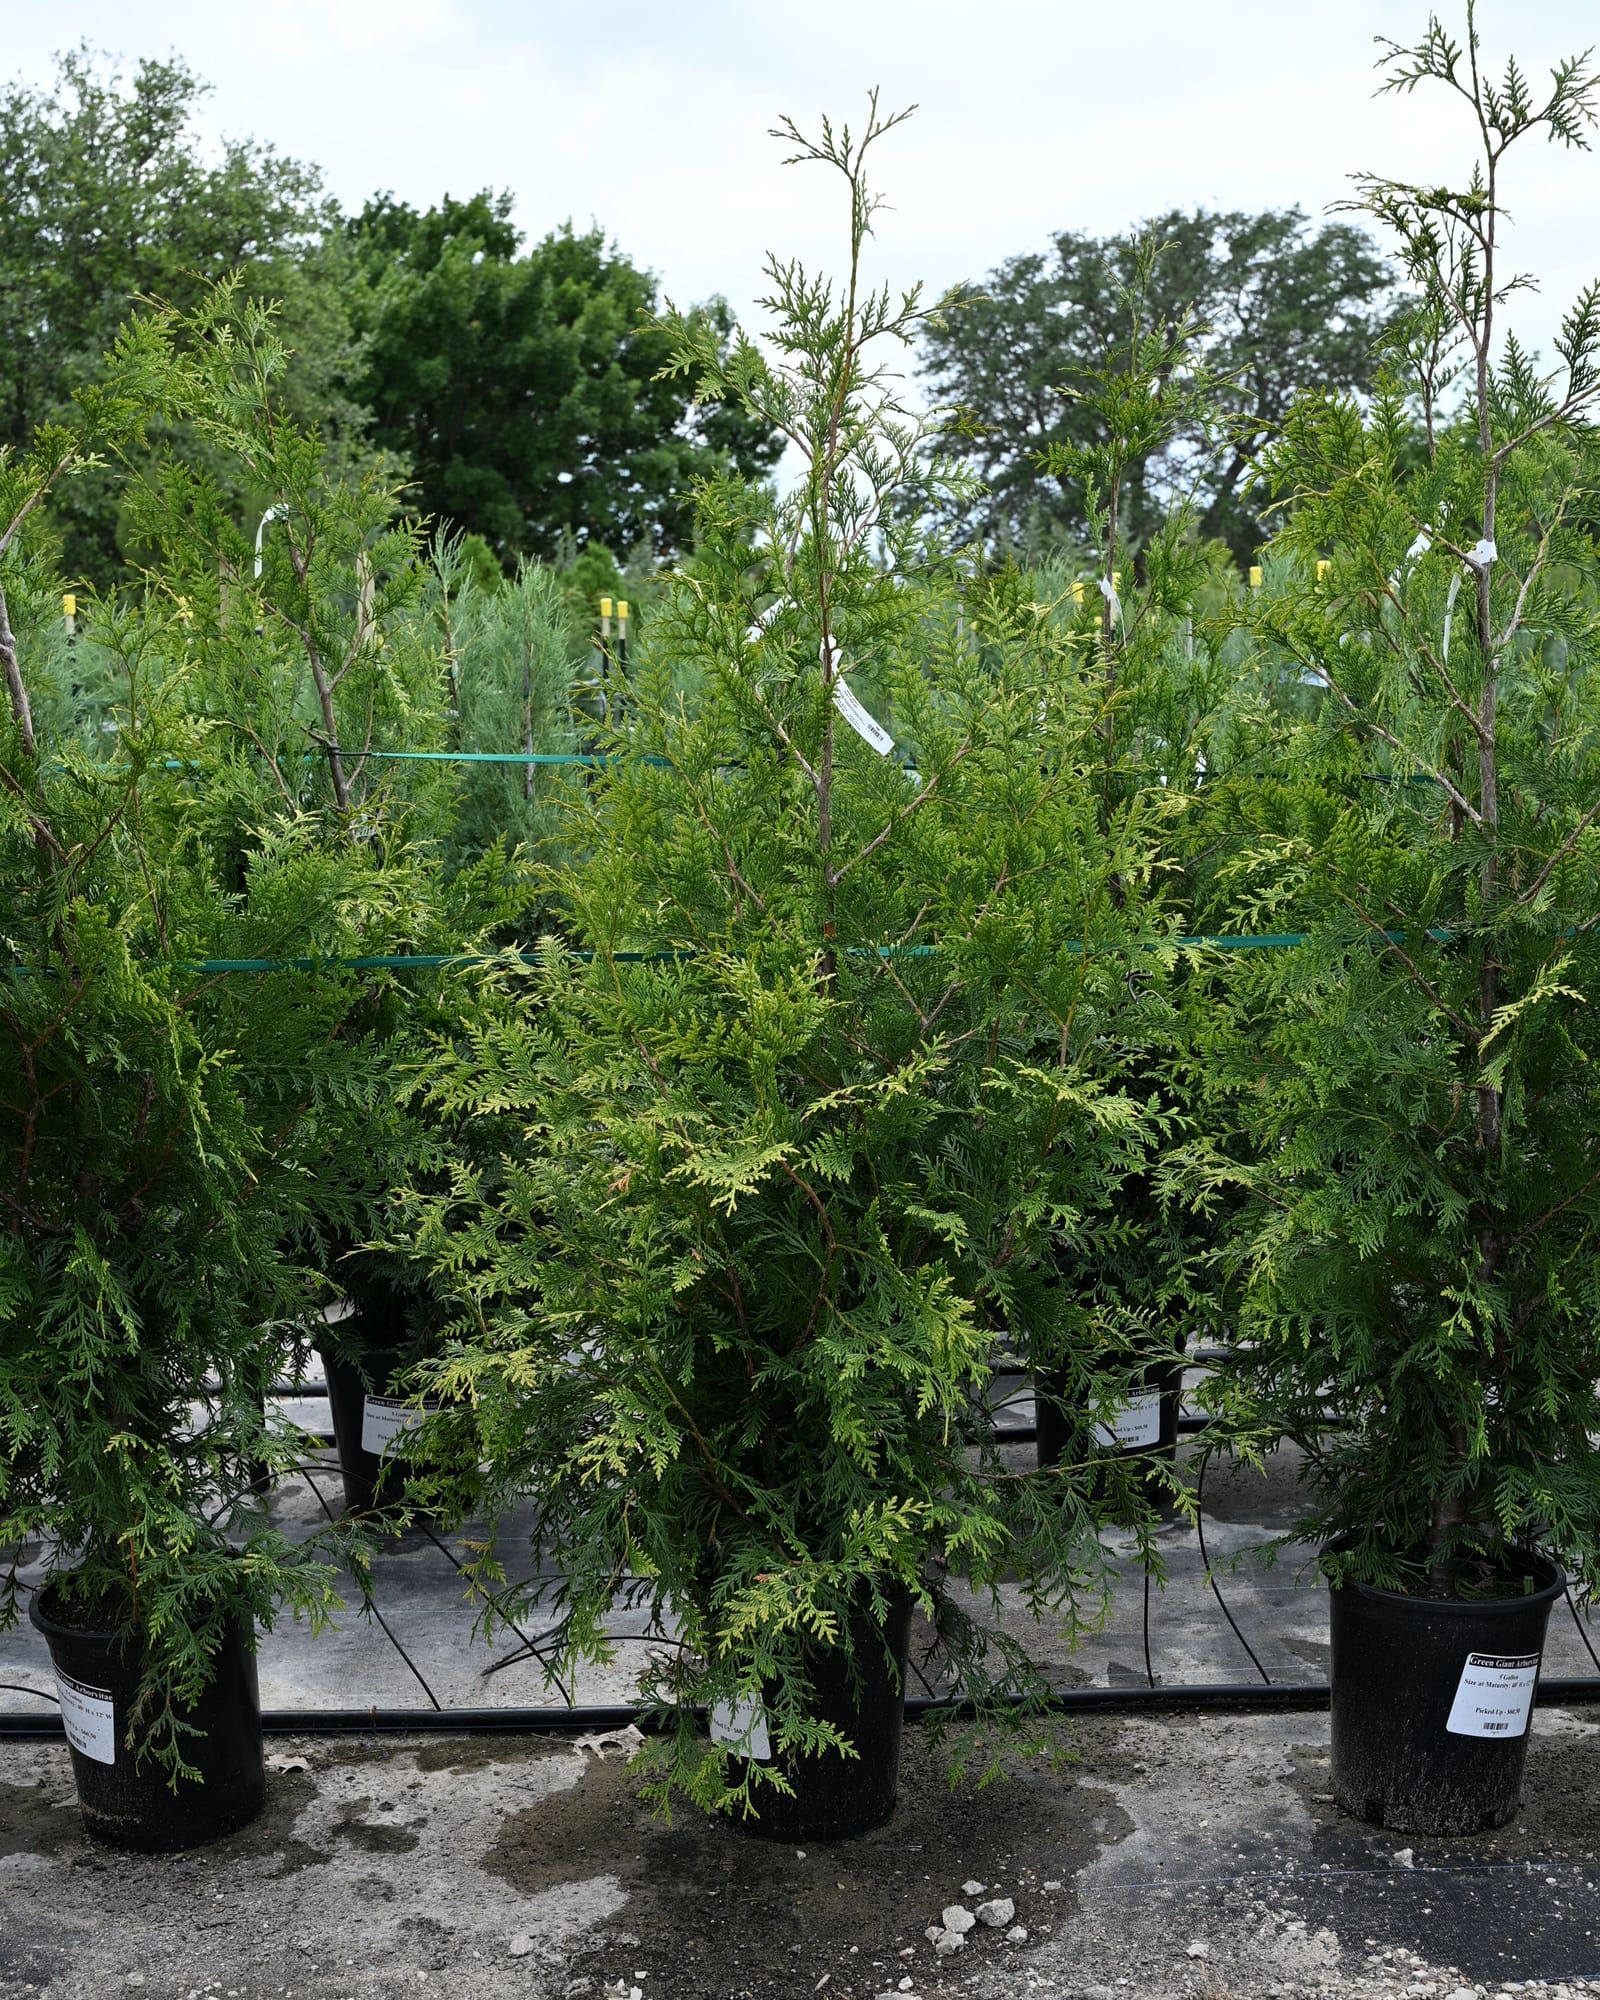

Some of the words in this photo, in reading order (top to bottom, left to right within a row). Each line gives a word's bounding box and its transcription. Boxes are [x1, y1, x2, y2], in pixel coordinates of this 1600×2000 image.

[367, 1396, 385, 1406] Green
[386, 1399, 403, 1408] Gian
[1470, 1656, 1495, 1667] Green
[1495, 1659, 1515, 1668] Giant
[75, 1686, 113, 1701] Arborvitae
[1476, 1707, 1495, 1715] Picked
